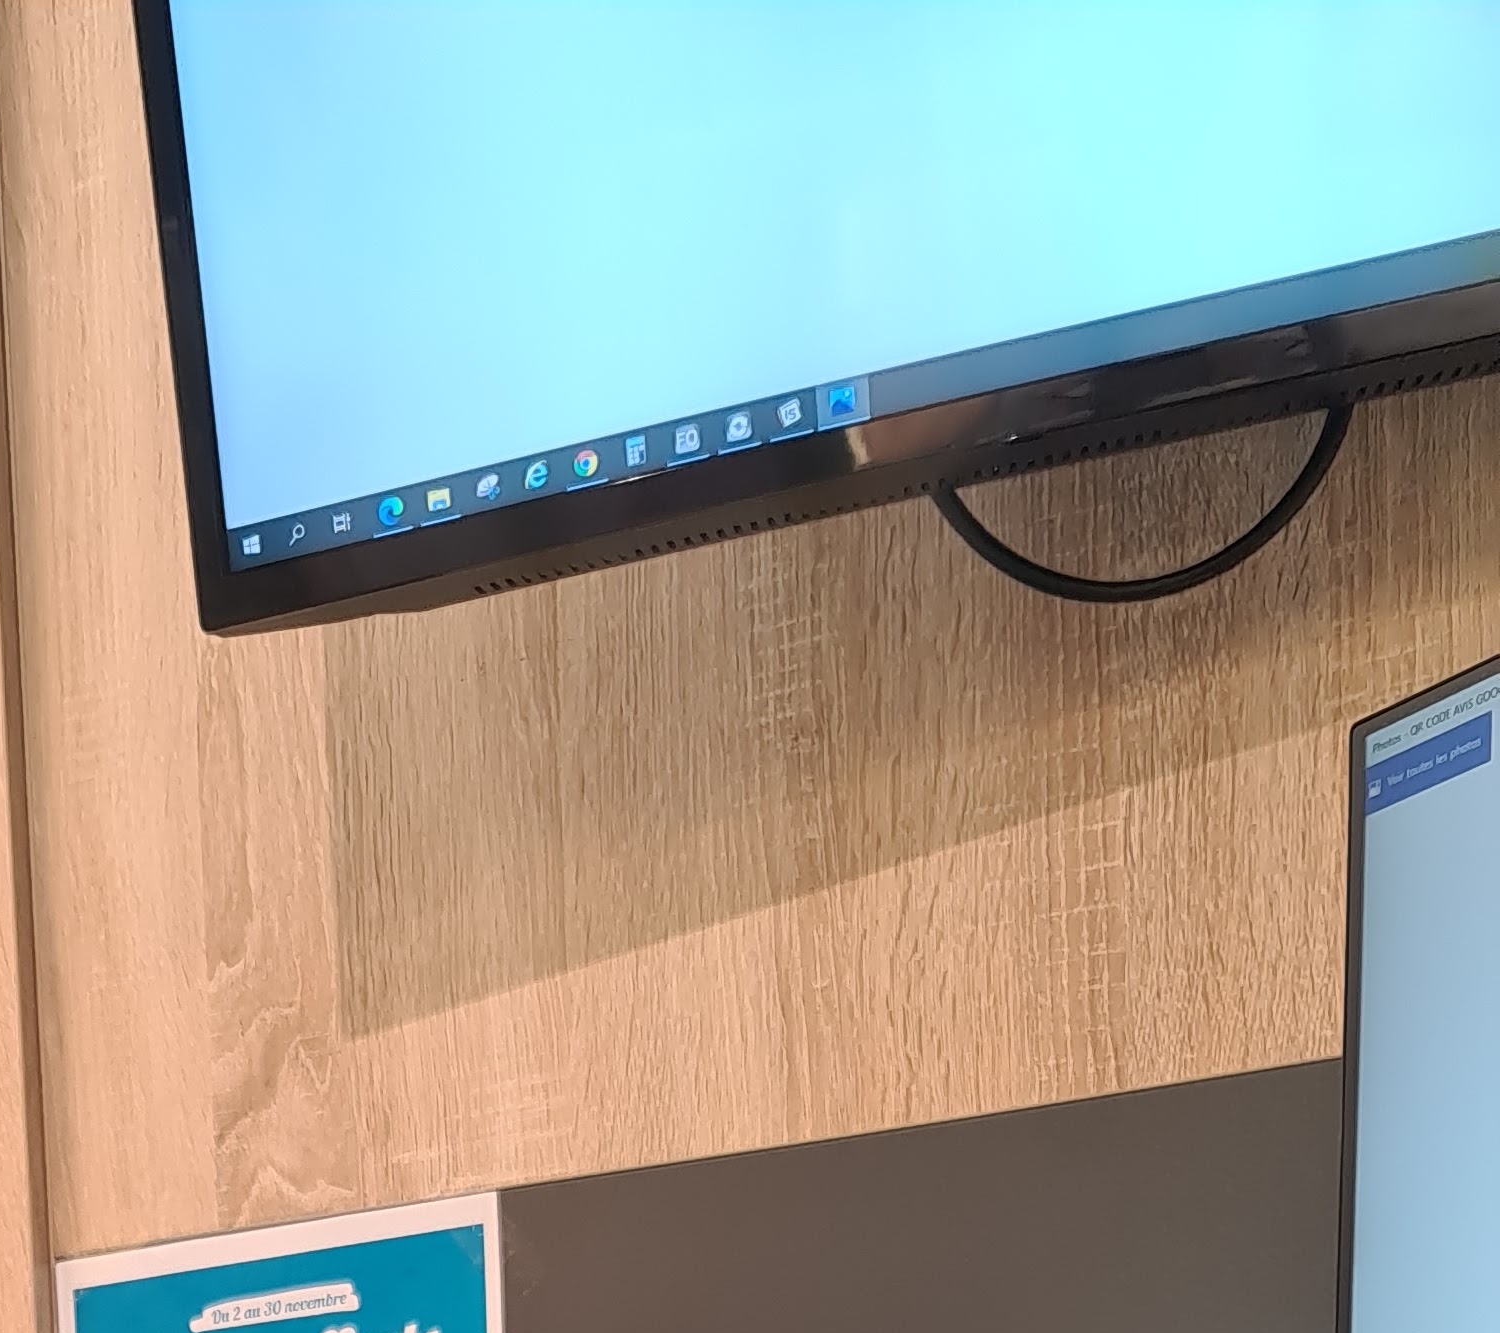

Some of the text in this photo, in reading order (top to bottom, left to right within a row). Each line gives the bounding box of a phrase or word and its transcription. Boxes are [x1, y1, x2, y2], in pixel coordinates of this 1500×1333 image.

[1426, 709, 1452, 728] CODE
[1453, 698, 1473, 716] AVIS
[1450, 737, 1481, 761] photos
[211, 1292, 347, 1325] Du 2 au 30 novembre
